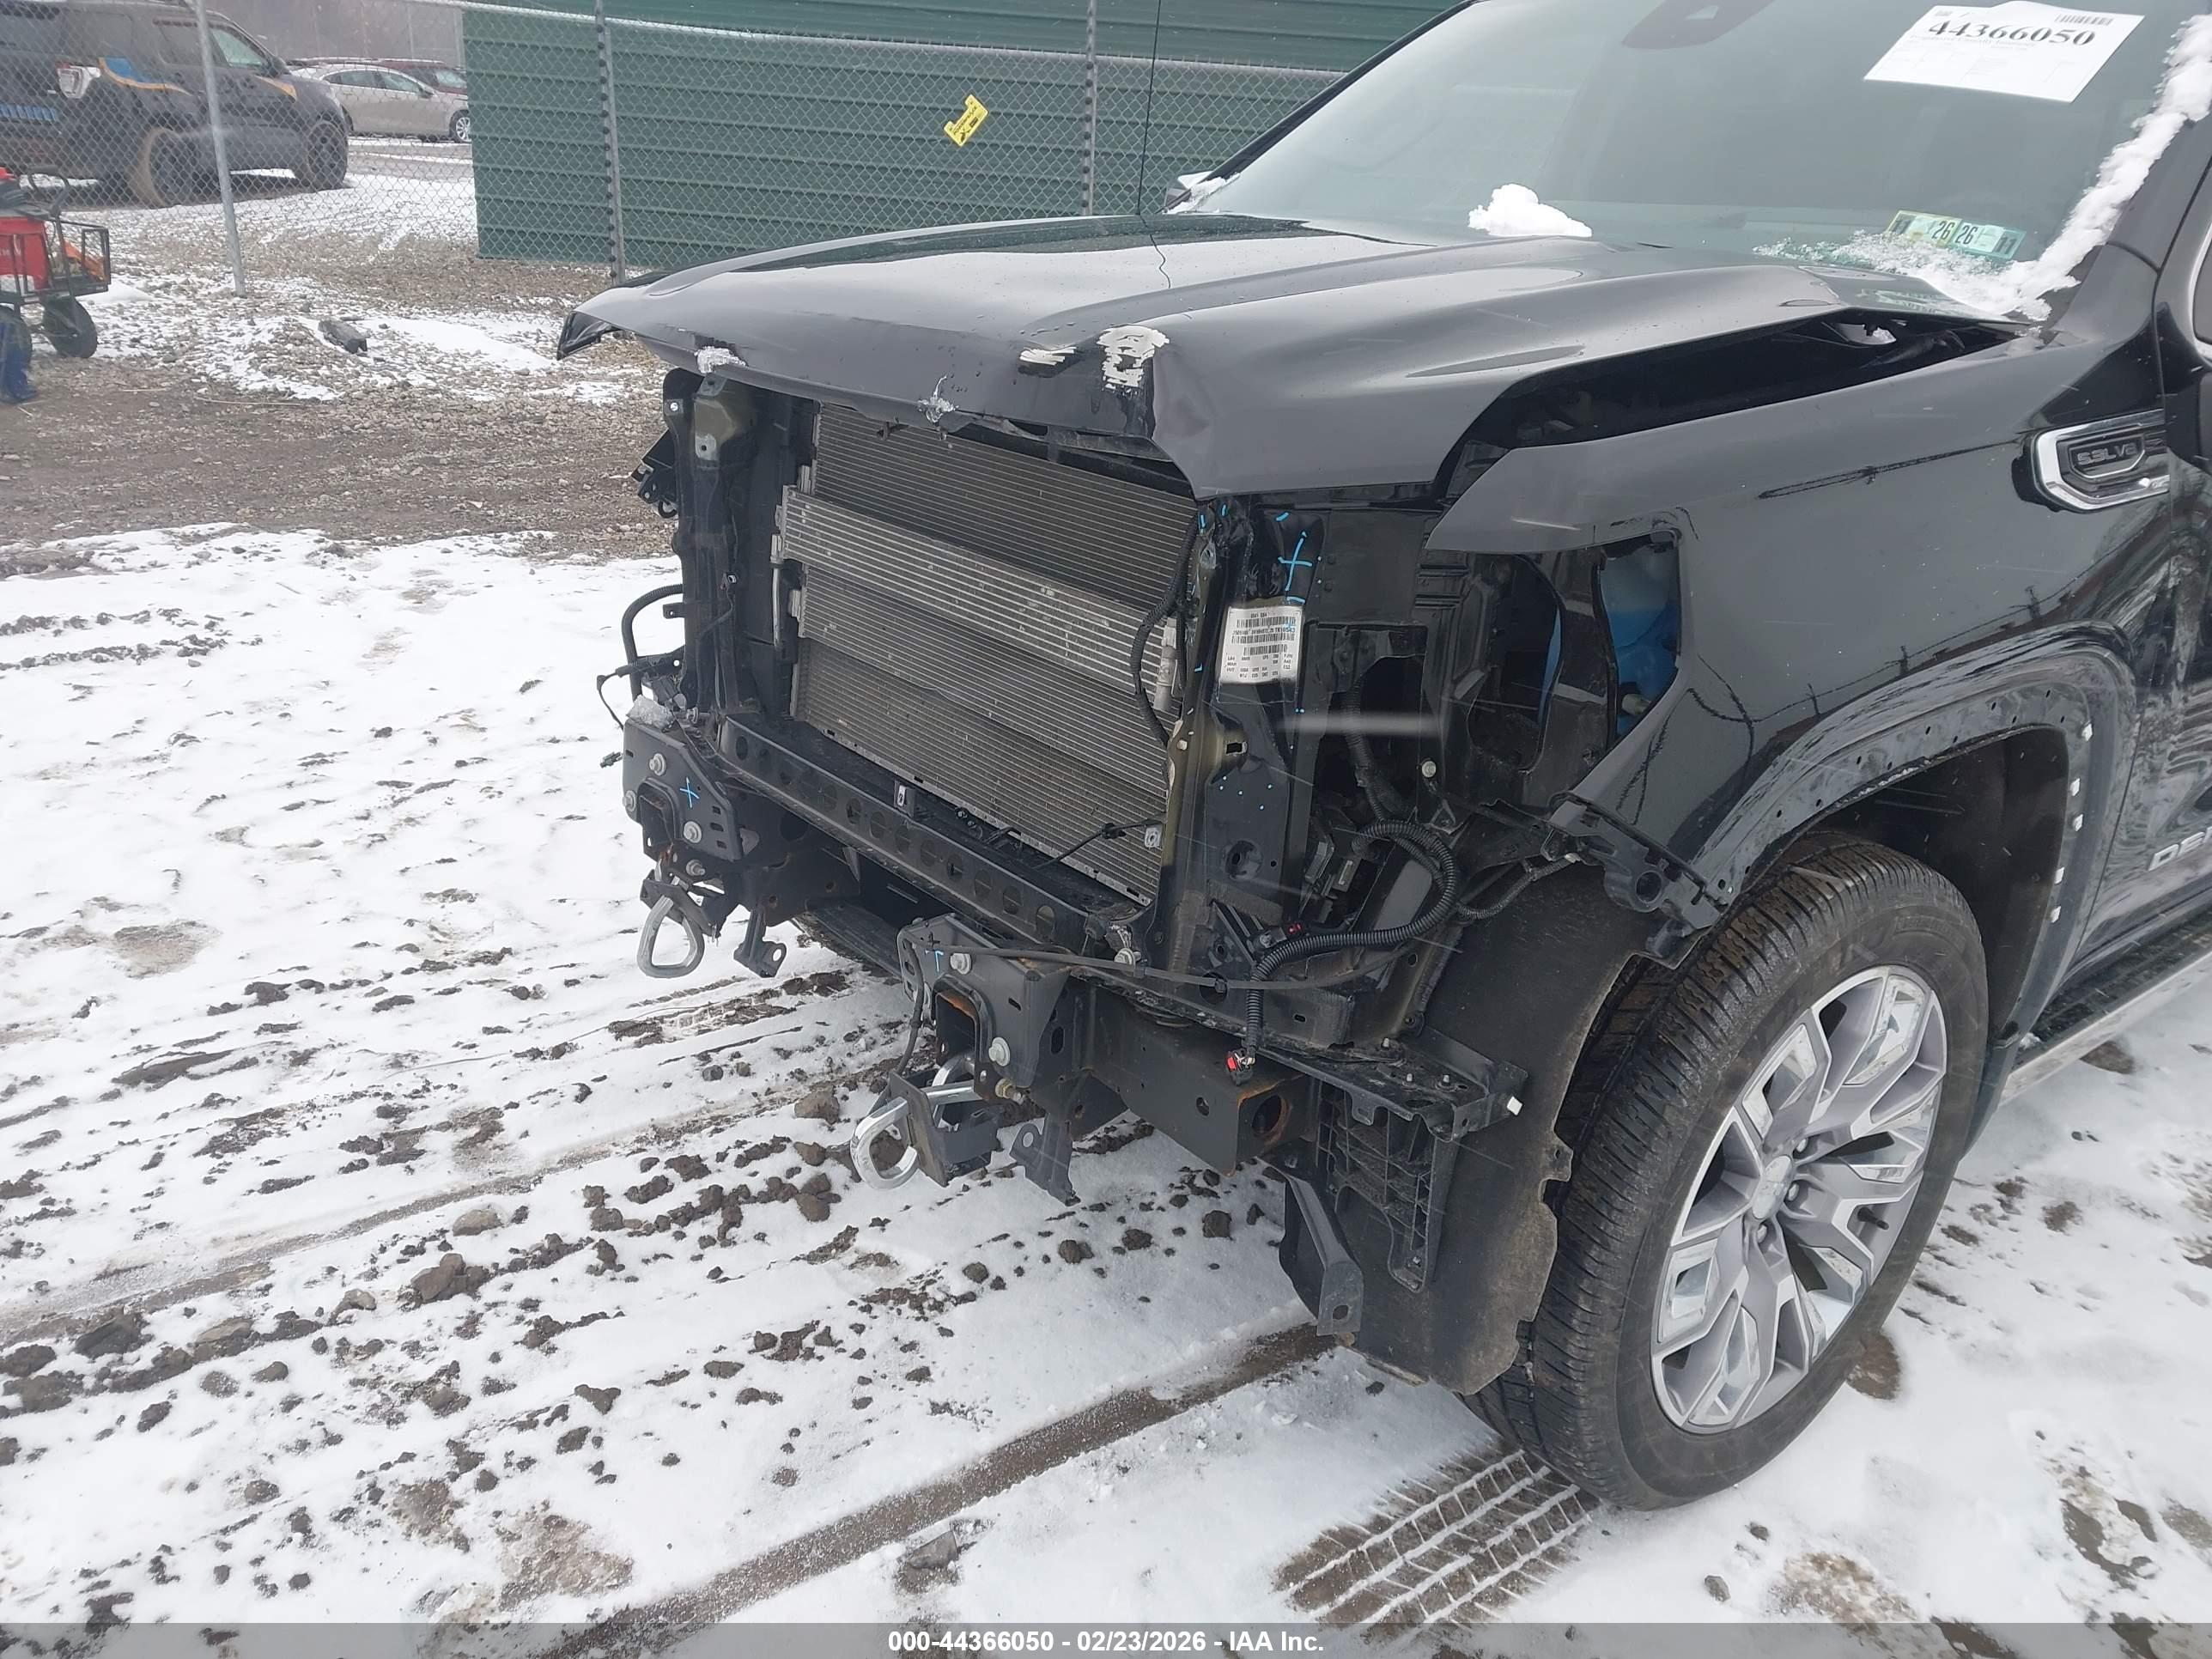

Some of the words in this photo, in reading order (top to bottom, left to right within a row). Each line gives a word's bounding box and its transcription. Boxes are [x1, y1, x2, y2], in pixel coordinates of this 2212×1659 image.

[1929, 20, 2095, 46] 44366050
[1932, 220, 1955, 240] 26
[1954, 224, 1978, 245] 26
